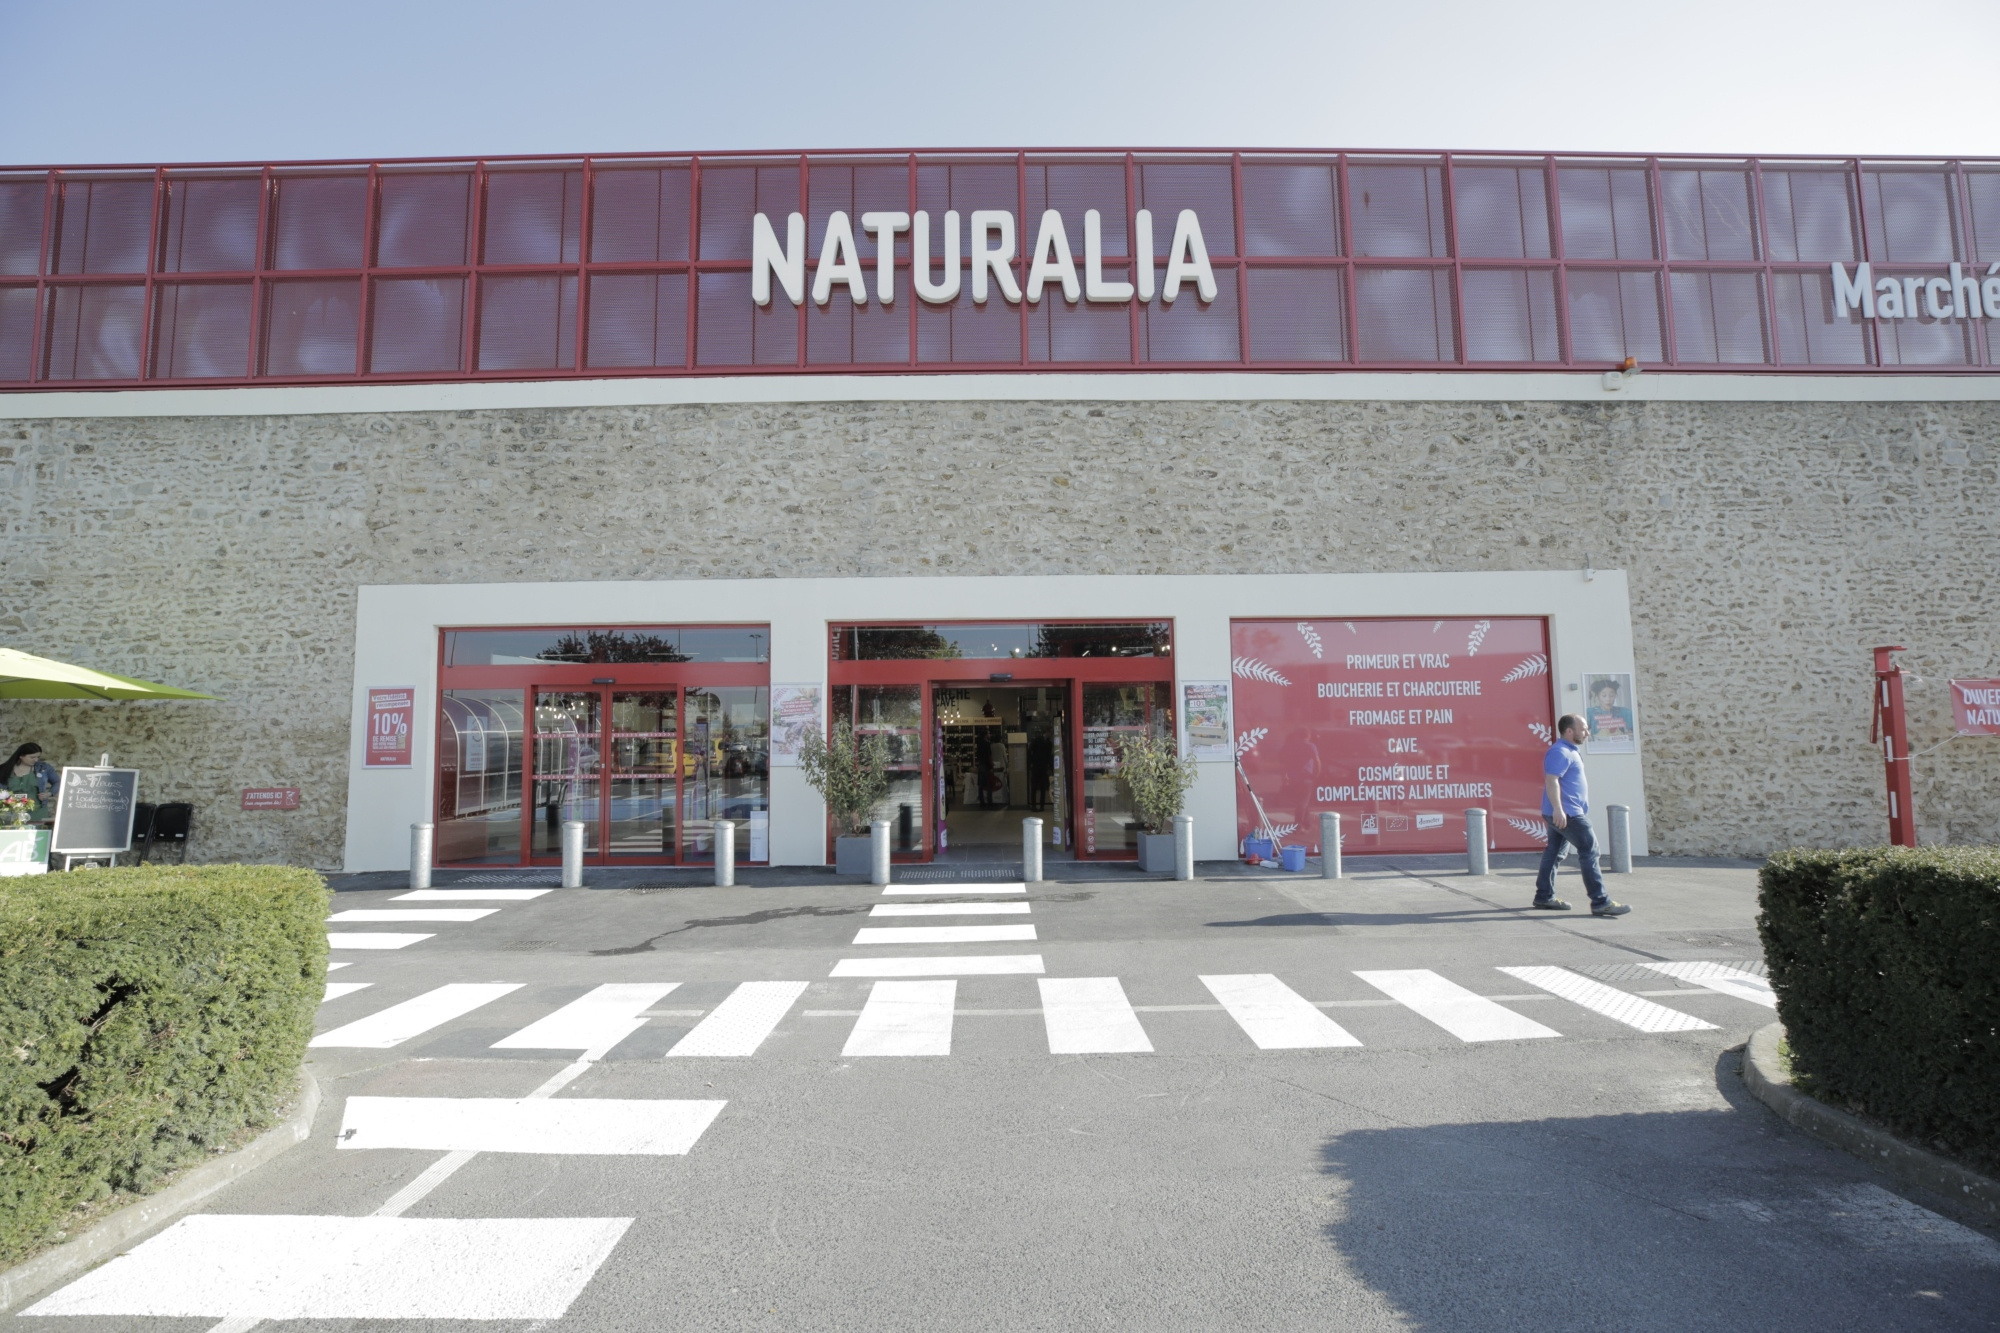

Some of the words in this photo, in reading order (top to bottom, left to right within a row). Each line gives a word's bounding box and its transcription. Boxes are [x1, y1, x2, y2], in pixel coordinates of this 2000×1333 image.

[752, 209, 1217, 305] NATURALIA
[1831, 262, 2000, 318] Marché
[1346, 654, 1400, 669] PRIMEUR
[1402, 654, 1416, 669] ET
[1419, 653, 1450, 669] VRAC
[1317, 682, 1384, 698] BOUCHERIE
[1386, 682, 1400, 697] ET
[1402, 680, 1482, 697] CHARCUTERIE
[373, 712, 407, 735] 10%
[1349, 710, 1406, 726] FROMAGE
[1408, 710, 1422, 725] ET
[1425, 709, 1453, 724] PAIN
[1388, 738, 1418, 753] CAVE
[86, 772, 123, 788] Fleurs
[1358, 763, 1433, 781] COSMÉTIQUE
[1436, 765, 1449, 780] ET
[1316, 783, 1405, 802] COMPLÉMENTS
[1408, 783, 1492, 800] ALIMENTAIRES
[1418, 817, 1440, 826] demeter
